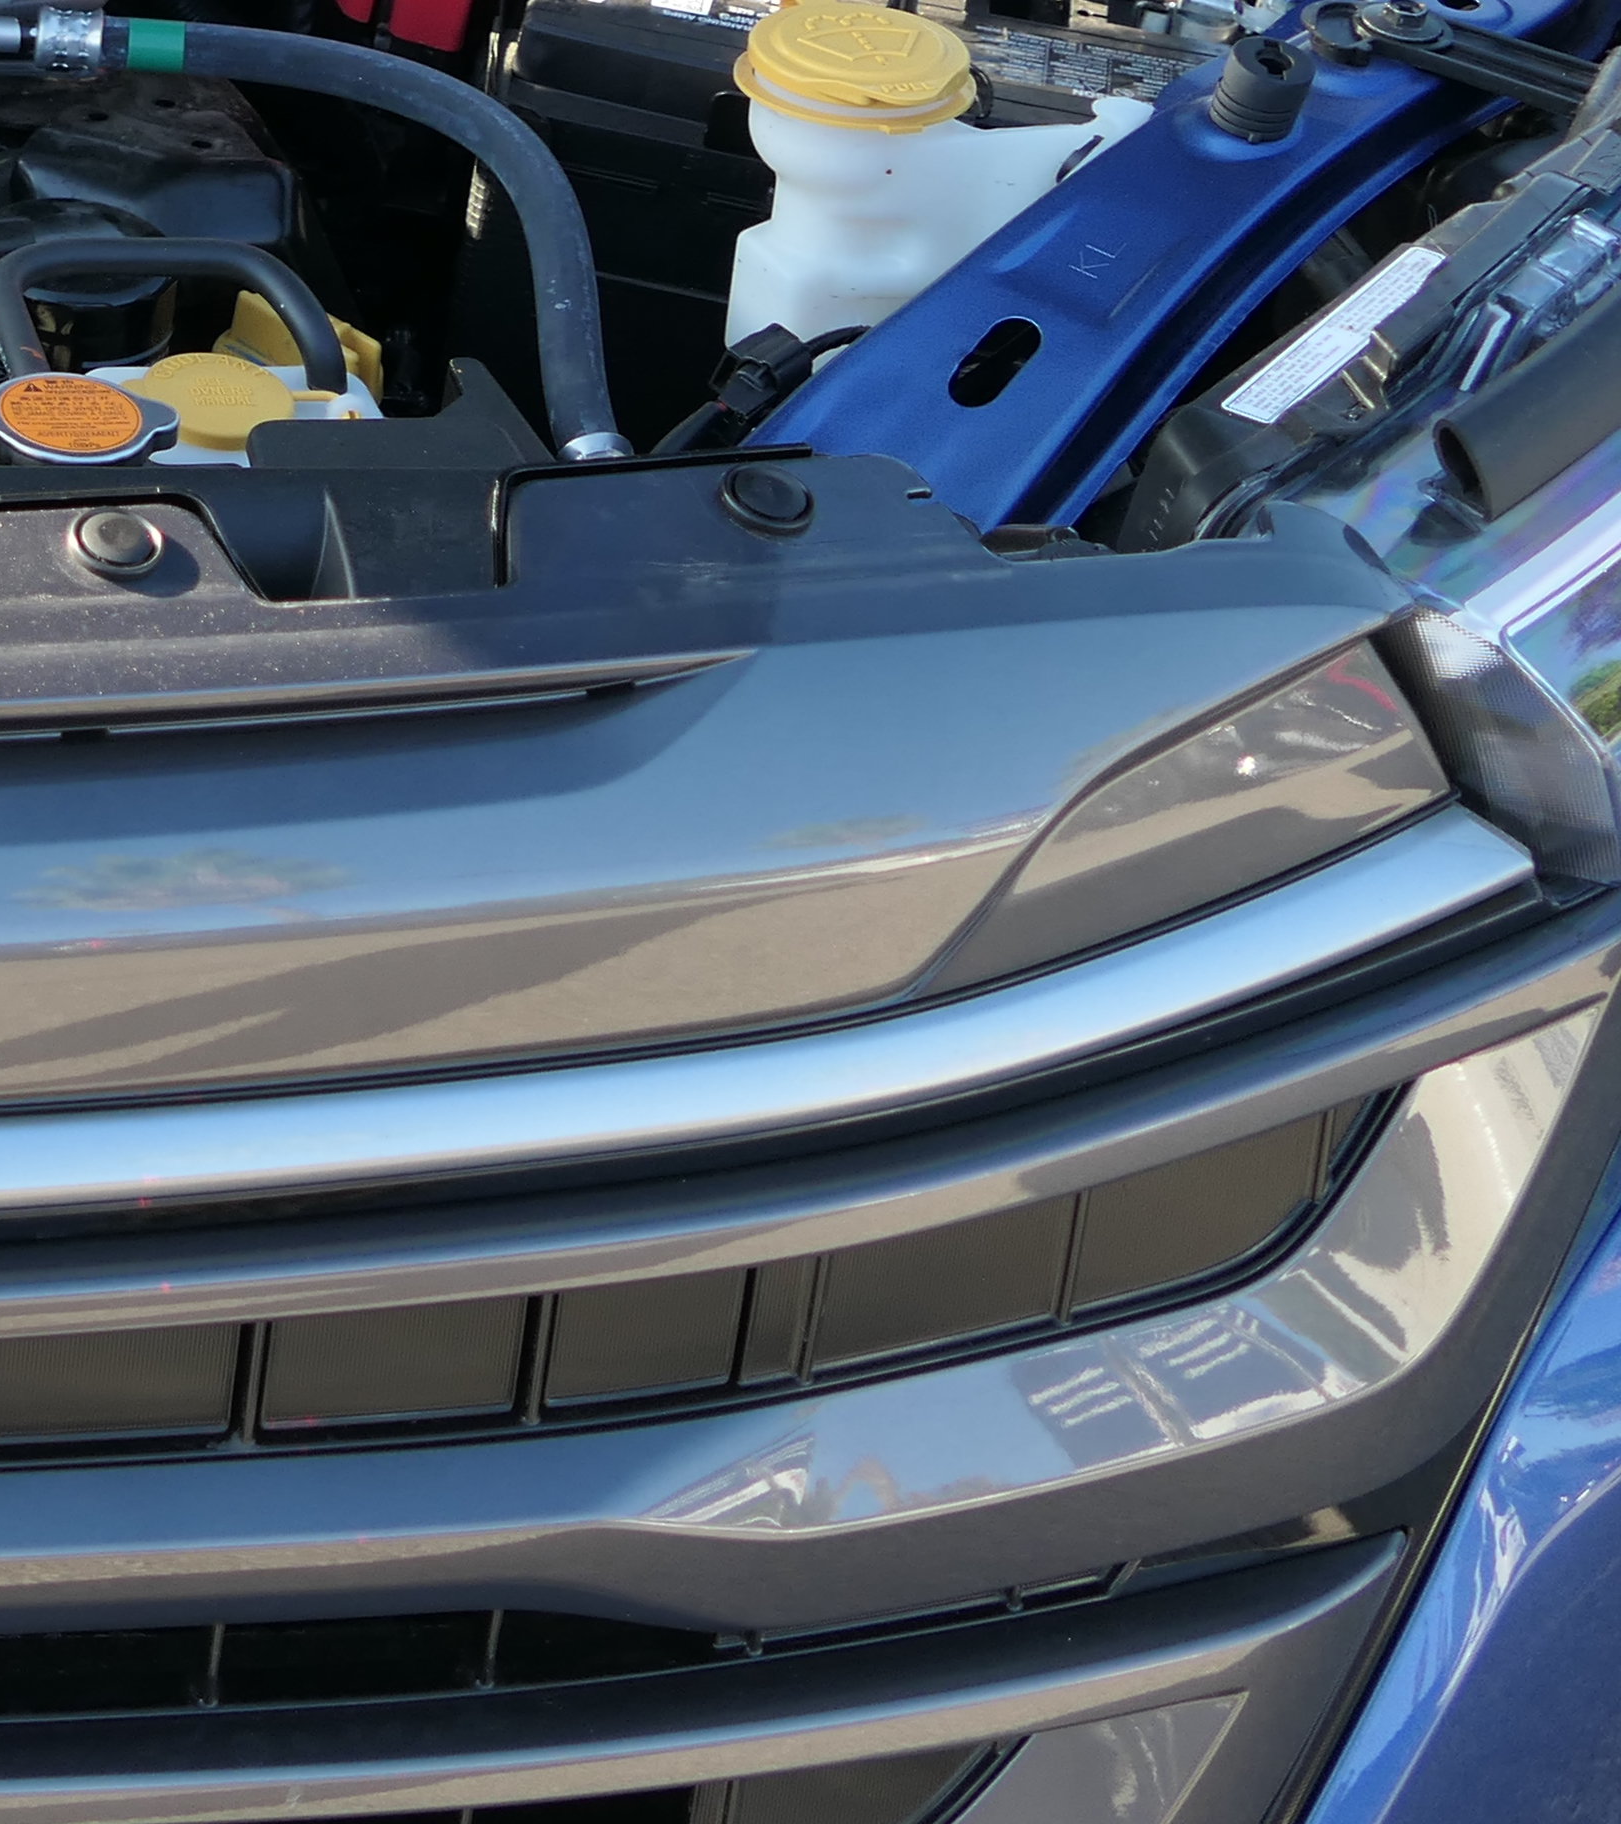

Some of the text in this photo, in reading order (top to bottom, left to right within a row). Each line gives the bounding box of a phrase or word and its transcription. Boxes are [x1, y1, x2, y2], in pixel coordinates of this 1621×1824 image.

[880, 81, 934, 94] PULL
[1068, 242, 1128, 279] KL
[153, 353, 269, 380] COOLANT
